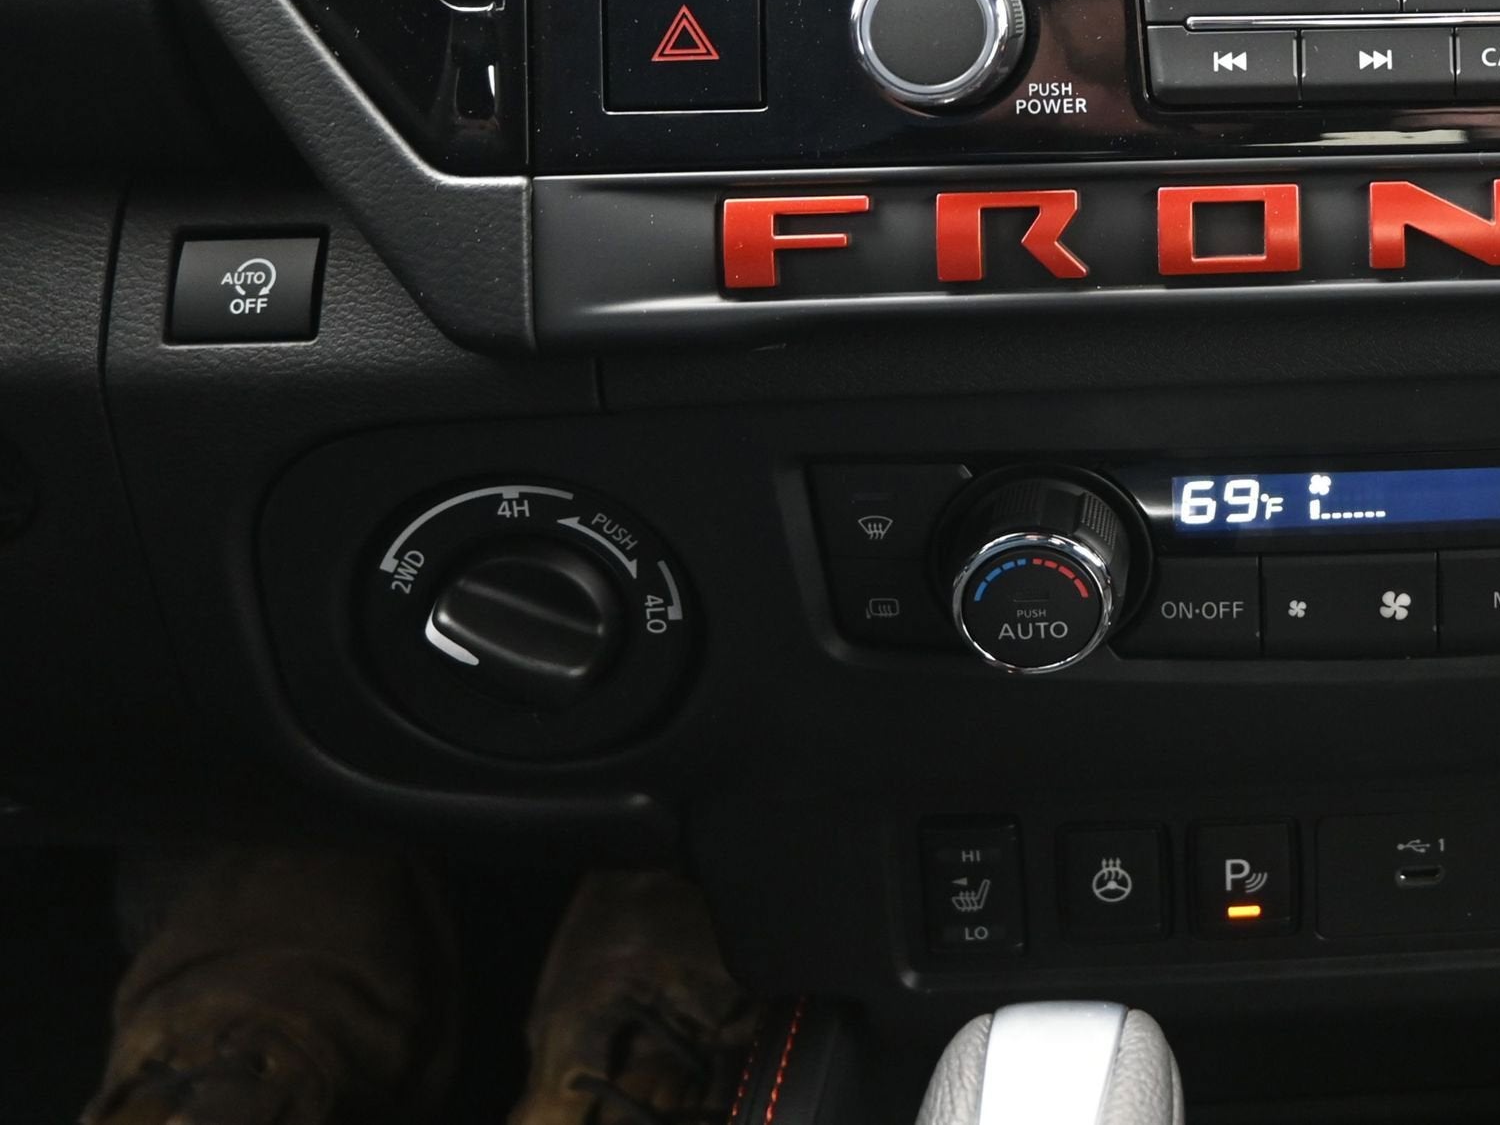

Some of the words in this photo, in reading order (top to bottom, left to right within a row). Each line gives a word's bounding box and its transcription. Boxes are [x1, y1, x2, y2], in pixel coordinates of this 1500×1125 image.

[1028, 82, 1072, 97] PUSH
[1015, 97, 1088, 115] POWER
[220, 271, 266, 286] AUTO
[229, 297, 268, 315] OFF
[497, 499, 531, 518] 4H
[590, 512, 637, 552] PUSH
[390, 549, 426, 595] 2WD
[644, 594, 668, 634] 4LO
[1016, 608, 1047, 619] PUSH
[998, 621, 1069, 640] AUTO
[1438, 838, 1445, 852] 1
[961, 850, 981, 863] HI
[964, 926, 989, 941] LO
